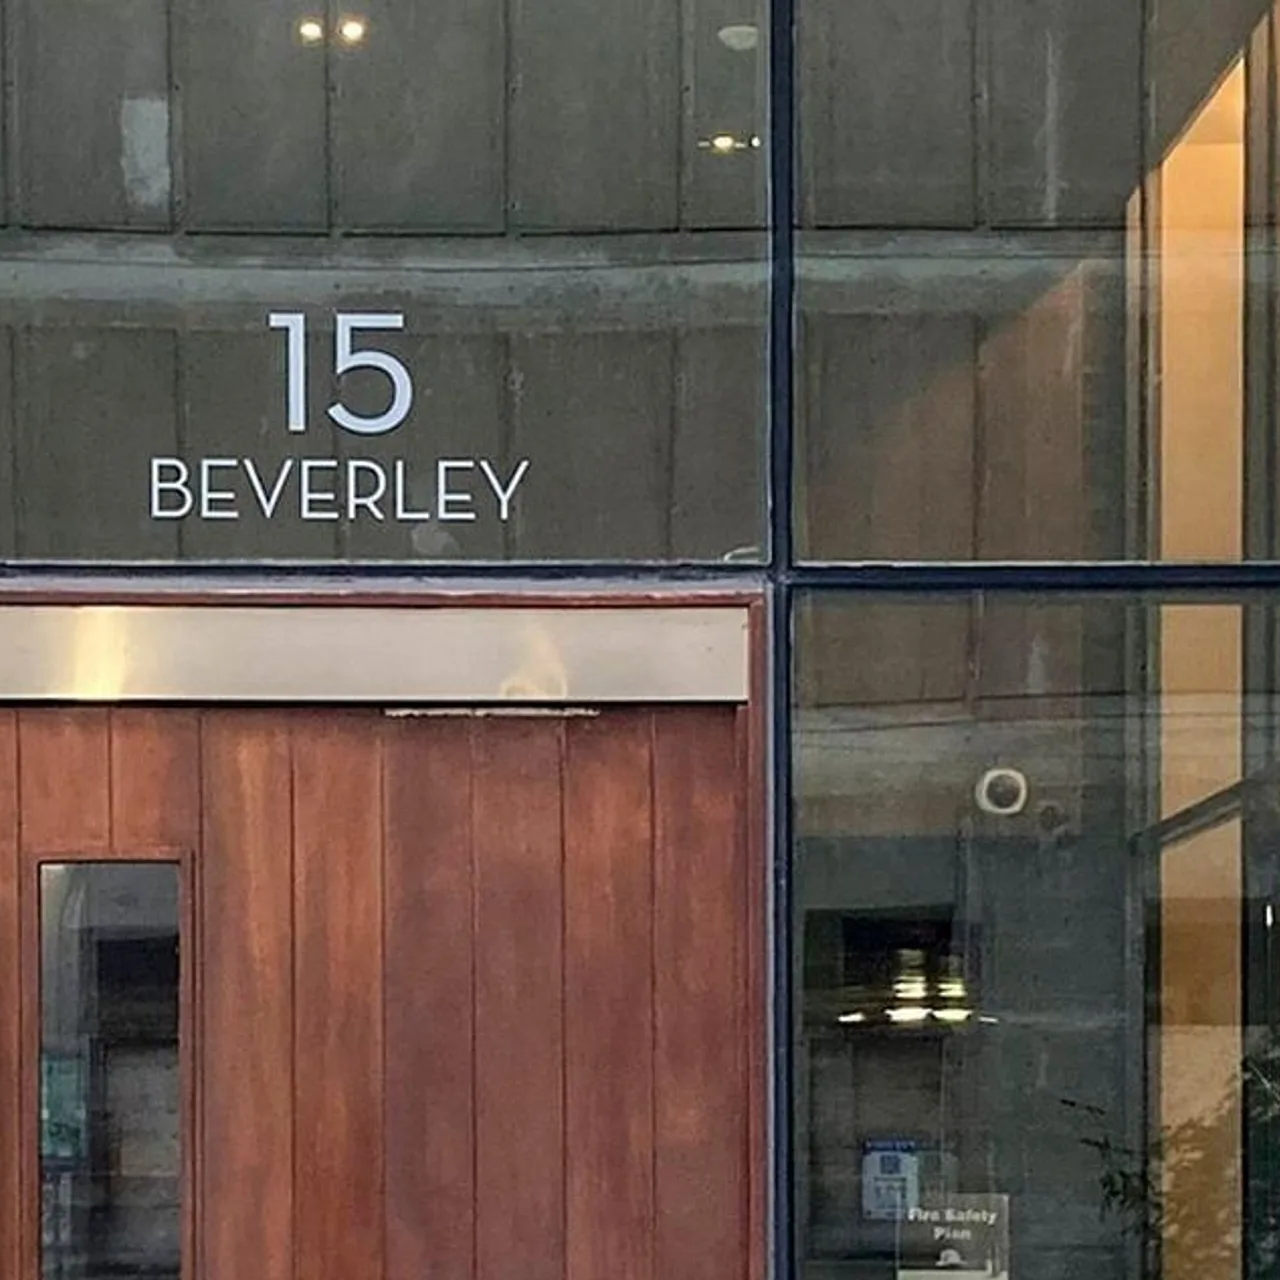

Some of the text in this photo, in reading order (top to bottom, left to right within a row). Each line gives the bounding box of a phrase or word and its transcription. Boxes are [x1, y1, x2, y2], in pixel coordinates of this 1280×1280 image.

[269, 313, 414, 435] 15
[150, 458, 531, 521] BEVERLEY
[907, 1207, 998, 1225] Fire Safety
[933, 1226, 972, 1240] Plan
